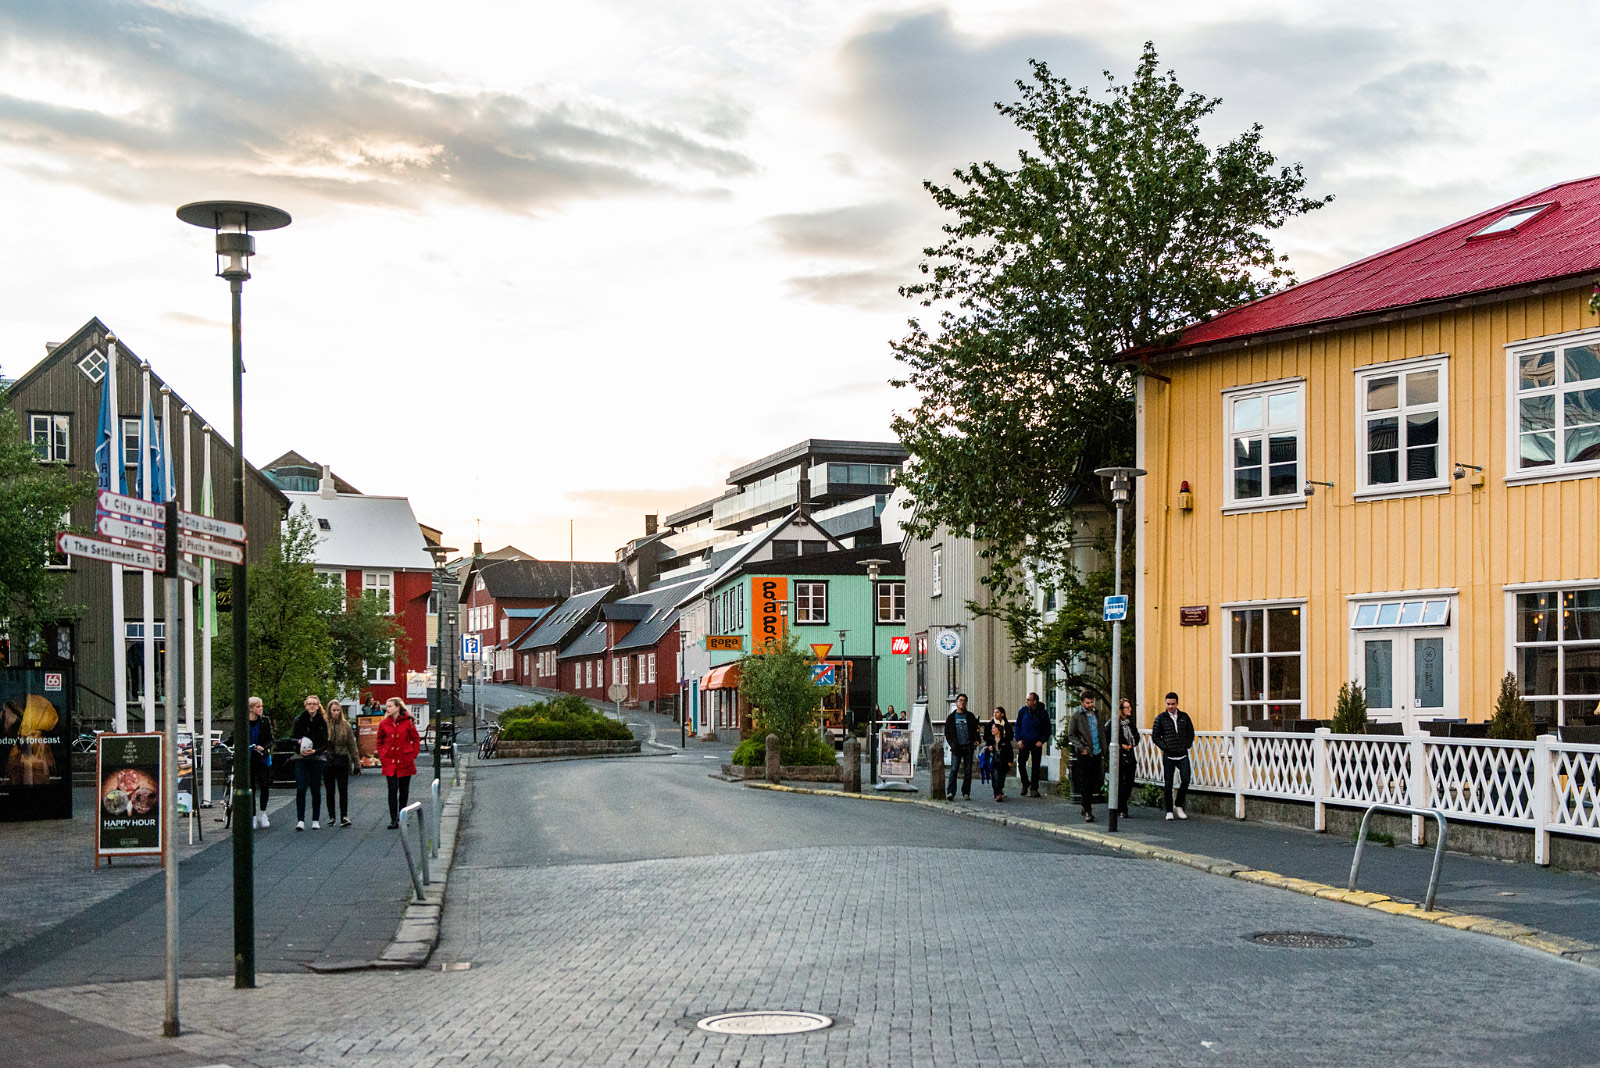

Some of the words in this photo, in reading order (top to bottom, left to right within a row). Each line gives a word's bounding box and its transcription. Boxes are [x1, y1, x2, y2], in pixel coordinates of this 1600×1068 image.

[114, 498, 131, 513] City
[136, 504, 153, 517] Hall
[185, 516, 199, 530] City
[203, 520, 226, 535] Library
[74, 540, 88, 553] The
[91, 544, 134, 561] Settlement
[187, 540, 205, 552] Photo
[208, 545, 233, 557] Museum
[762, 581, 778, 648] gaga
[710, 638, 739, 648] gaga
[892, 638, 909, 654] illy
[47, 675, 60, 686] 66
[26, 736, 61, 744] forecast
[103, 819, 131, 827] HAPPY
